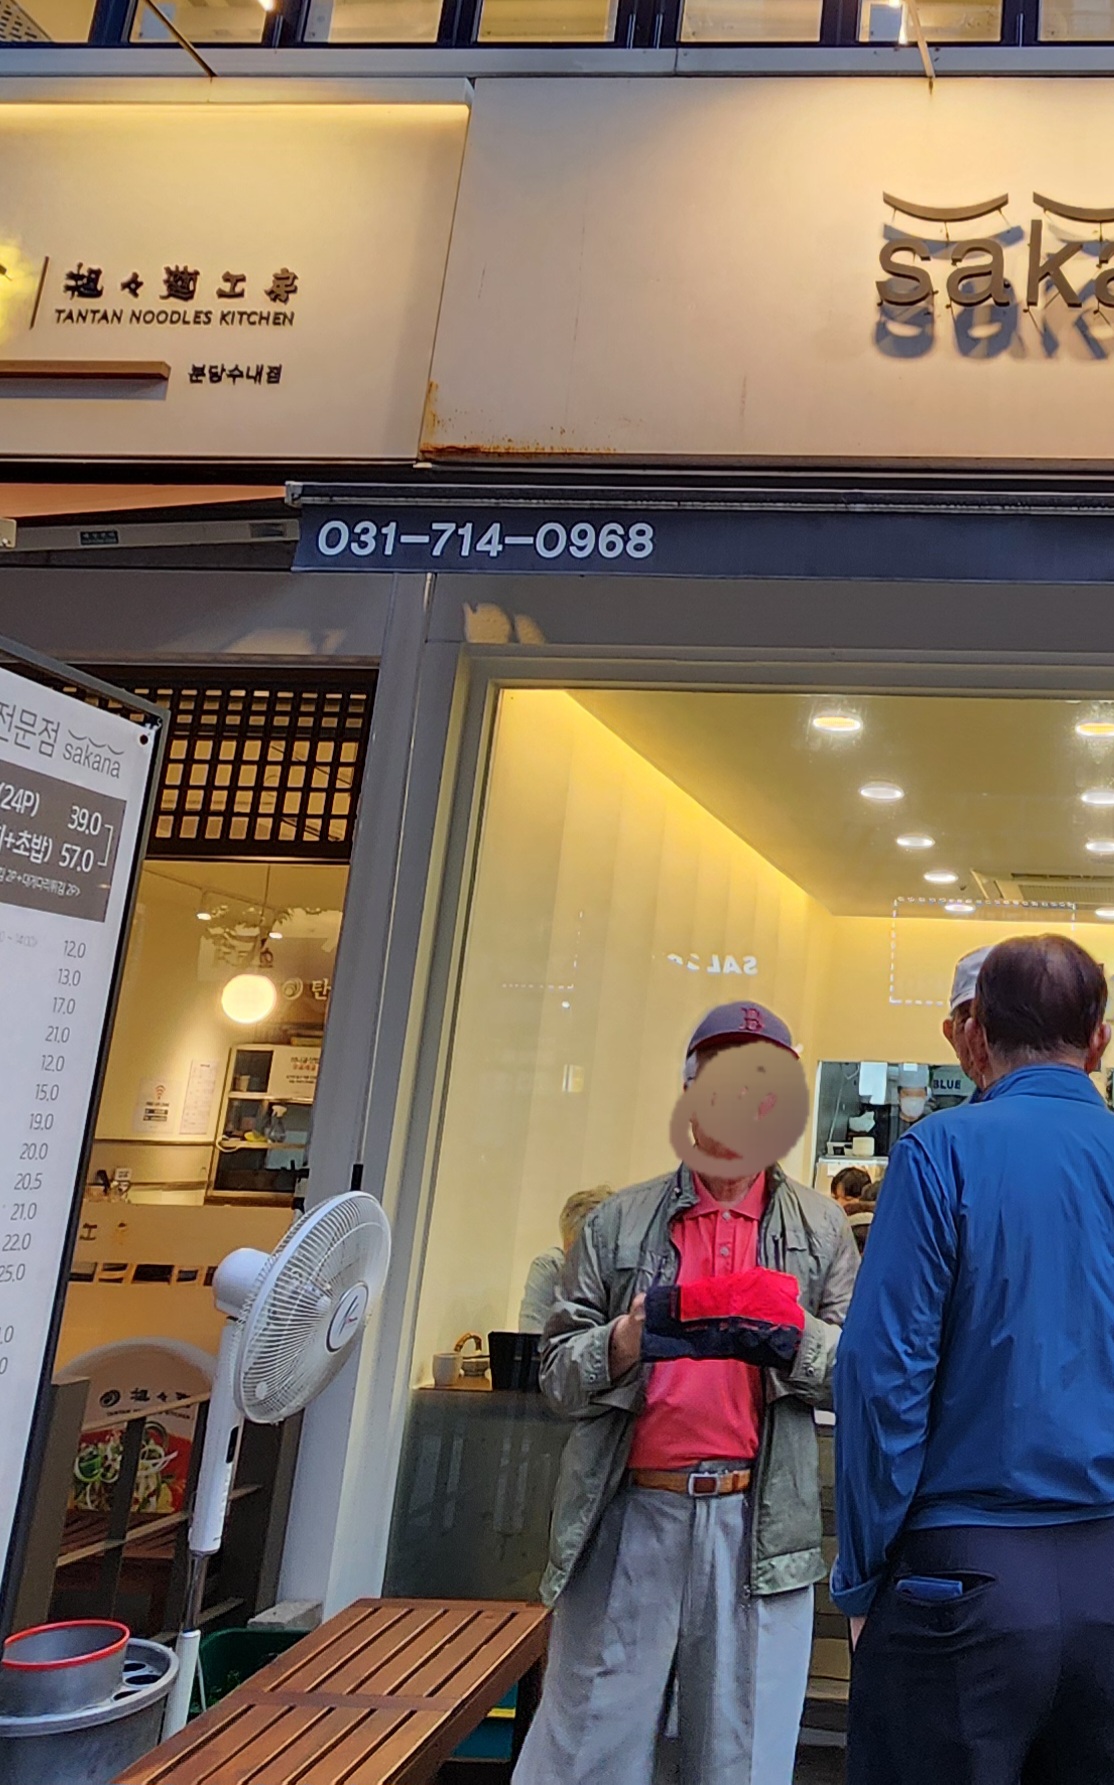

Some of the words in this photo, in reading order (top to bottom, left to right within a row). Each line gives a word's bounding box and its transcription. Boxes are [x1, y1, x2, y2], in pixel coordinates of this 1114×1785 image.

[55, 308, 123, 325] TANTAN
[129, 309, 213, 326] NOODLES
[219, 310, 296, 327] KITCHEN
[187, 363, 283, 386] 분당수내점
[317, 519, 654, 560] 031-714-0968
[62, 733, 122, 780] sakana
[67, 804, 103, 836] 39.0
[58, 843, 95, 873] 57.0
[63, 940, 87, 959] 12.0
[57, 968, 82, 987] 13.0
[52, 996, 76, 1015] 17.0
[739, 1006, 765, 1033] B
[45, 1025, 71, 1044] 21.0
[41, 1054, 66, 1072] 12.0
[35, 1083, 60, 1101] 15.0
[933, 1078, 962, 1090] BLUE
[29, 1113, 54, 1131] 19.0
[19, 1142, 49, 1161] 20.0
[14, 1172, 43, 1191] 20.5
[10, 1201, 37, 1221] 21.0
[1, 1232, 32, 1251] 22.0
